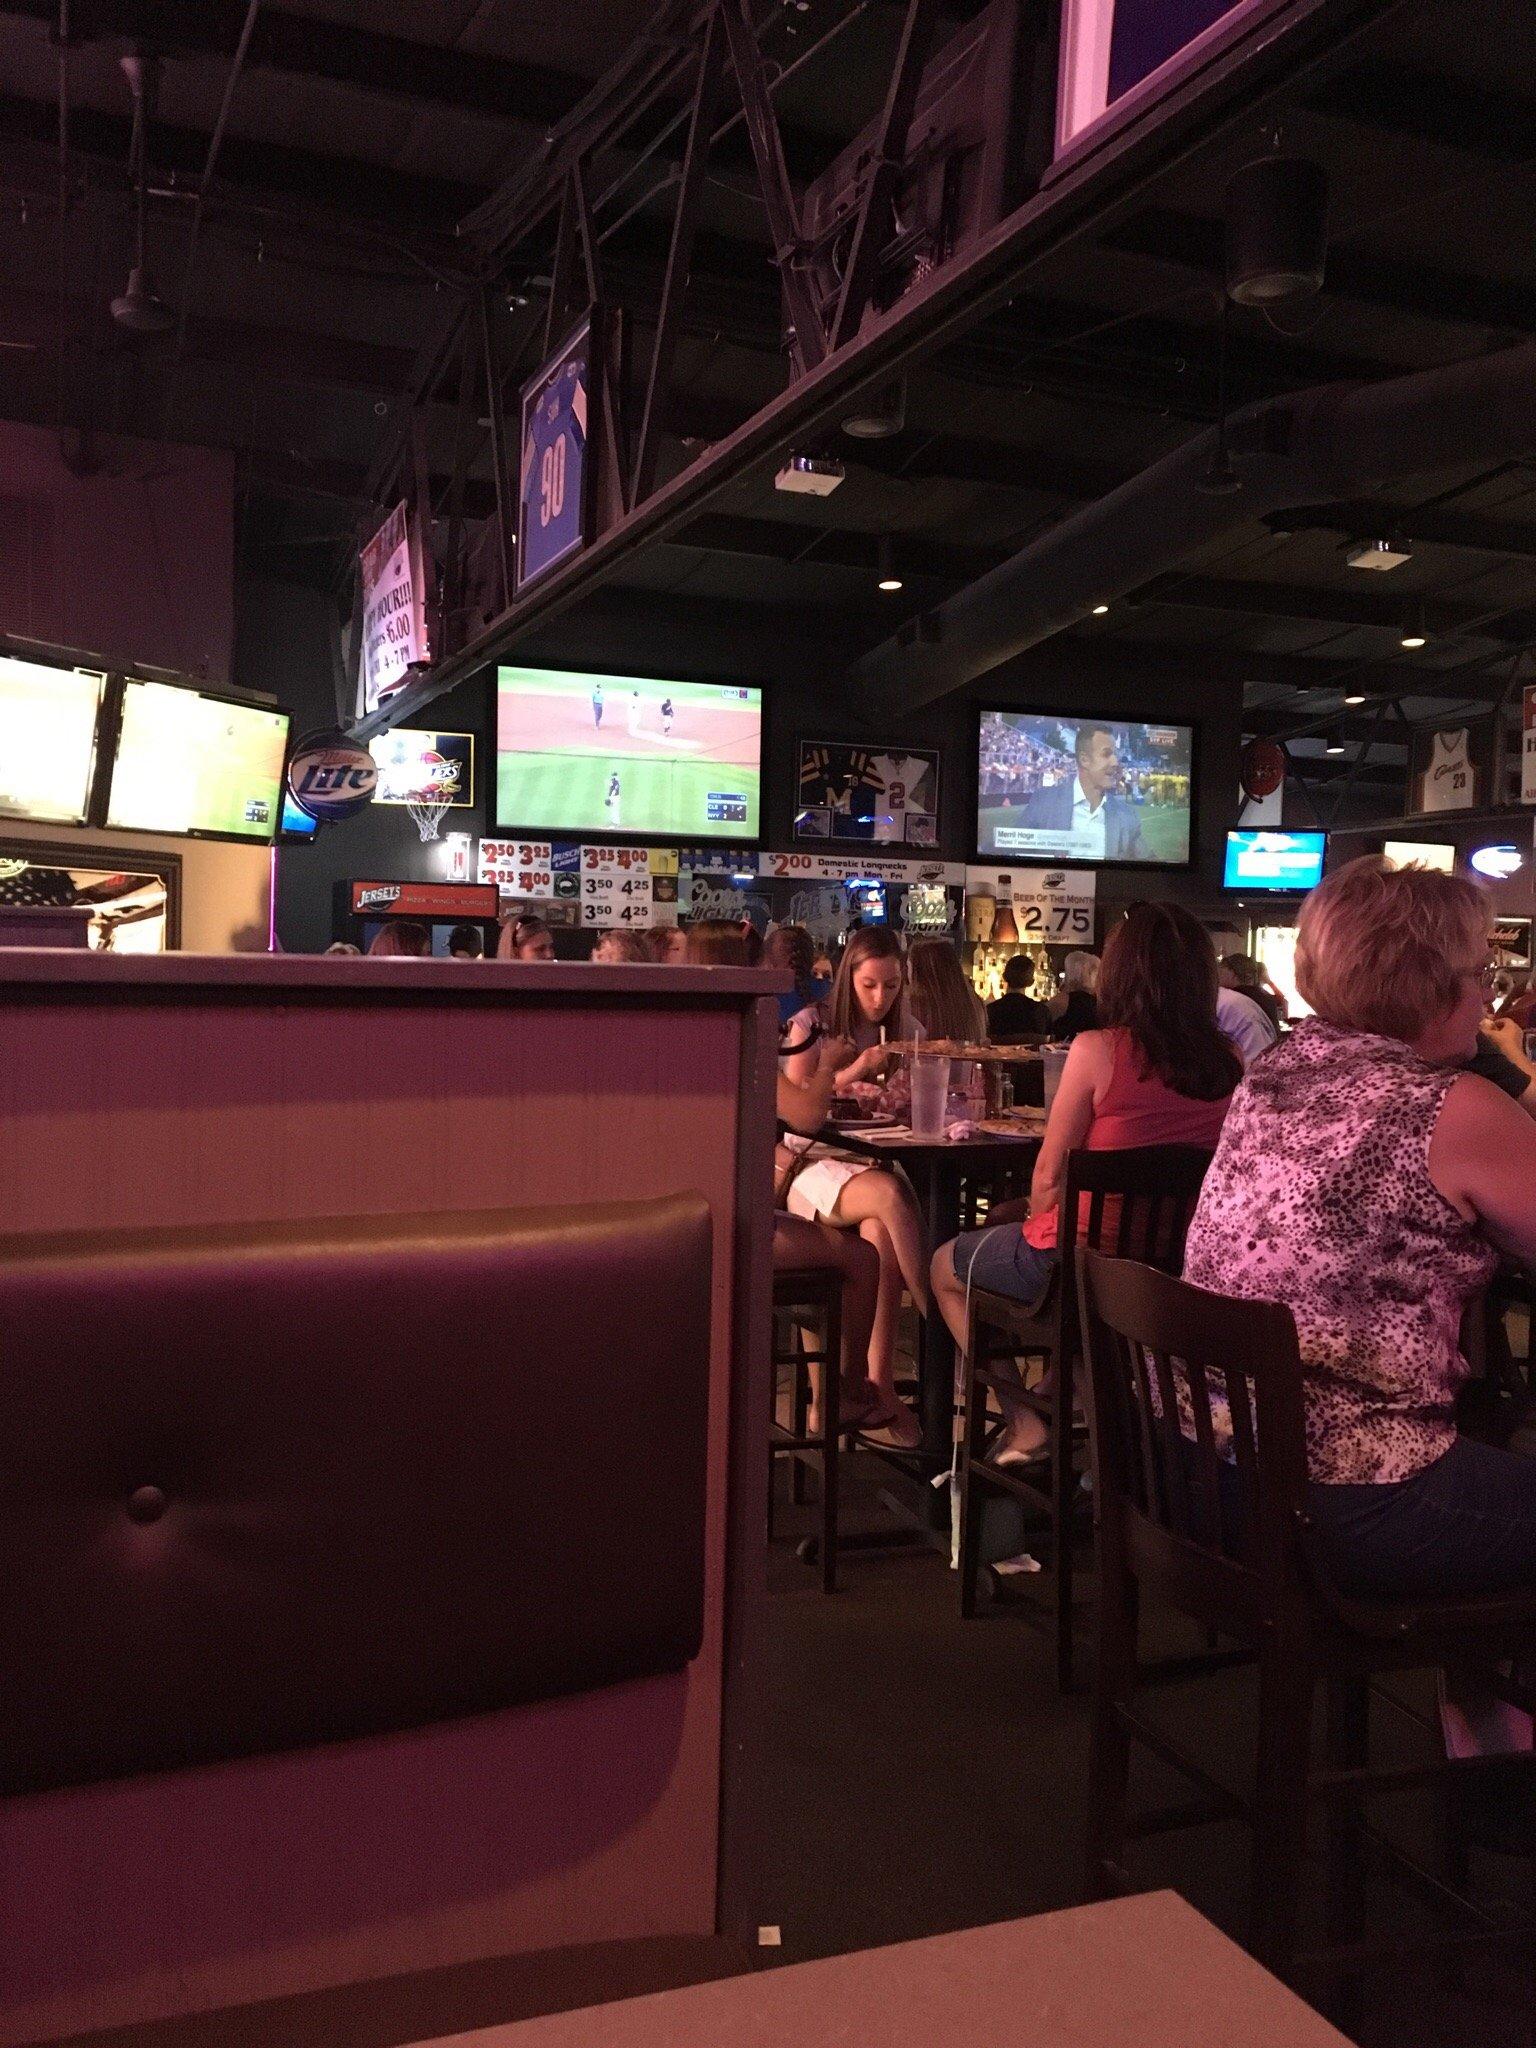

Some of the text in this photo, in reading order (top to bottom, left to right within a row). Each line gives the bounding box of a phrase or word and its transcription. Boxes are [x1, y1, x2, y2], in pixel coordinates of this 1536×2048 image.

[540, 432, 566, 528] 90
[298, 764, 375, 795] Lite
[889, 782, 906, 810] 2
[817, 858, 908, 871] Domestic Longnecks
[836, 870, 843, 878] 7
[863, 871, 883, 879] Mon
[890, 872, 903, 880] Fri
[357, 885, 401, 909] JERSEYS
[1013, 892, 1095, 904] BEER OF THE MONTH
[1020, 906, 1091, 933] $2.75
